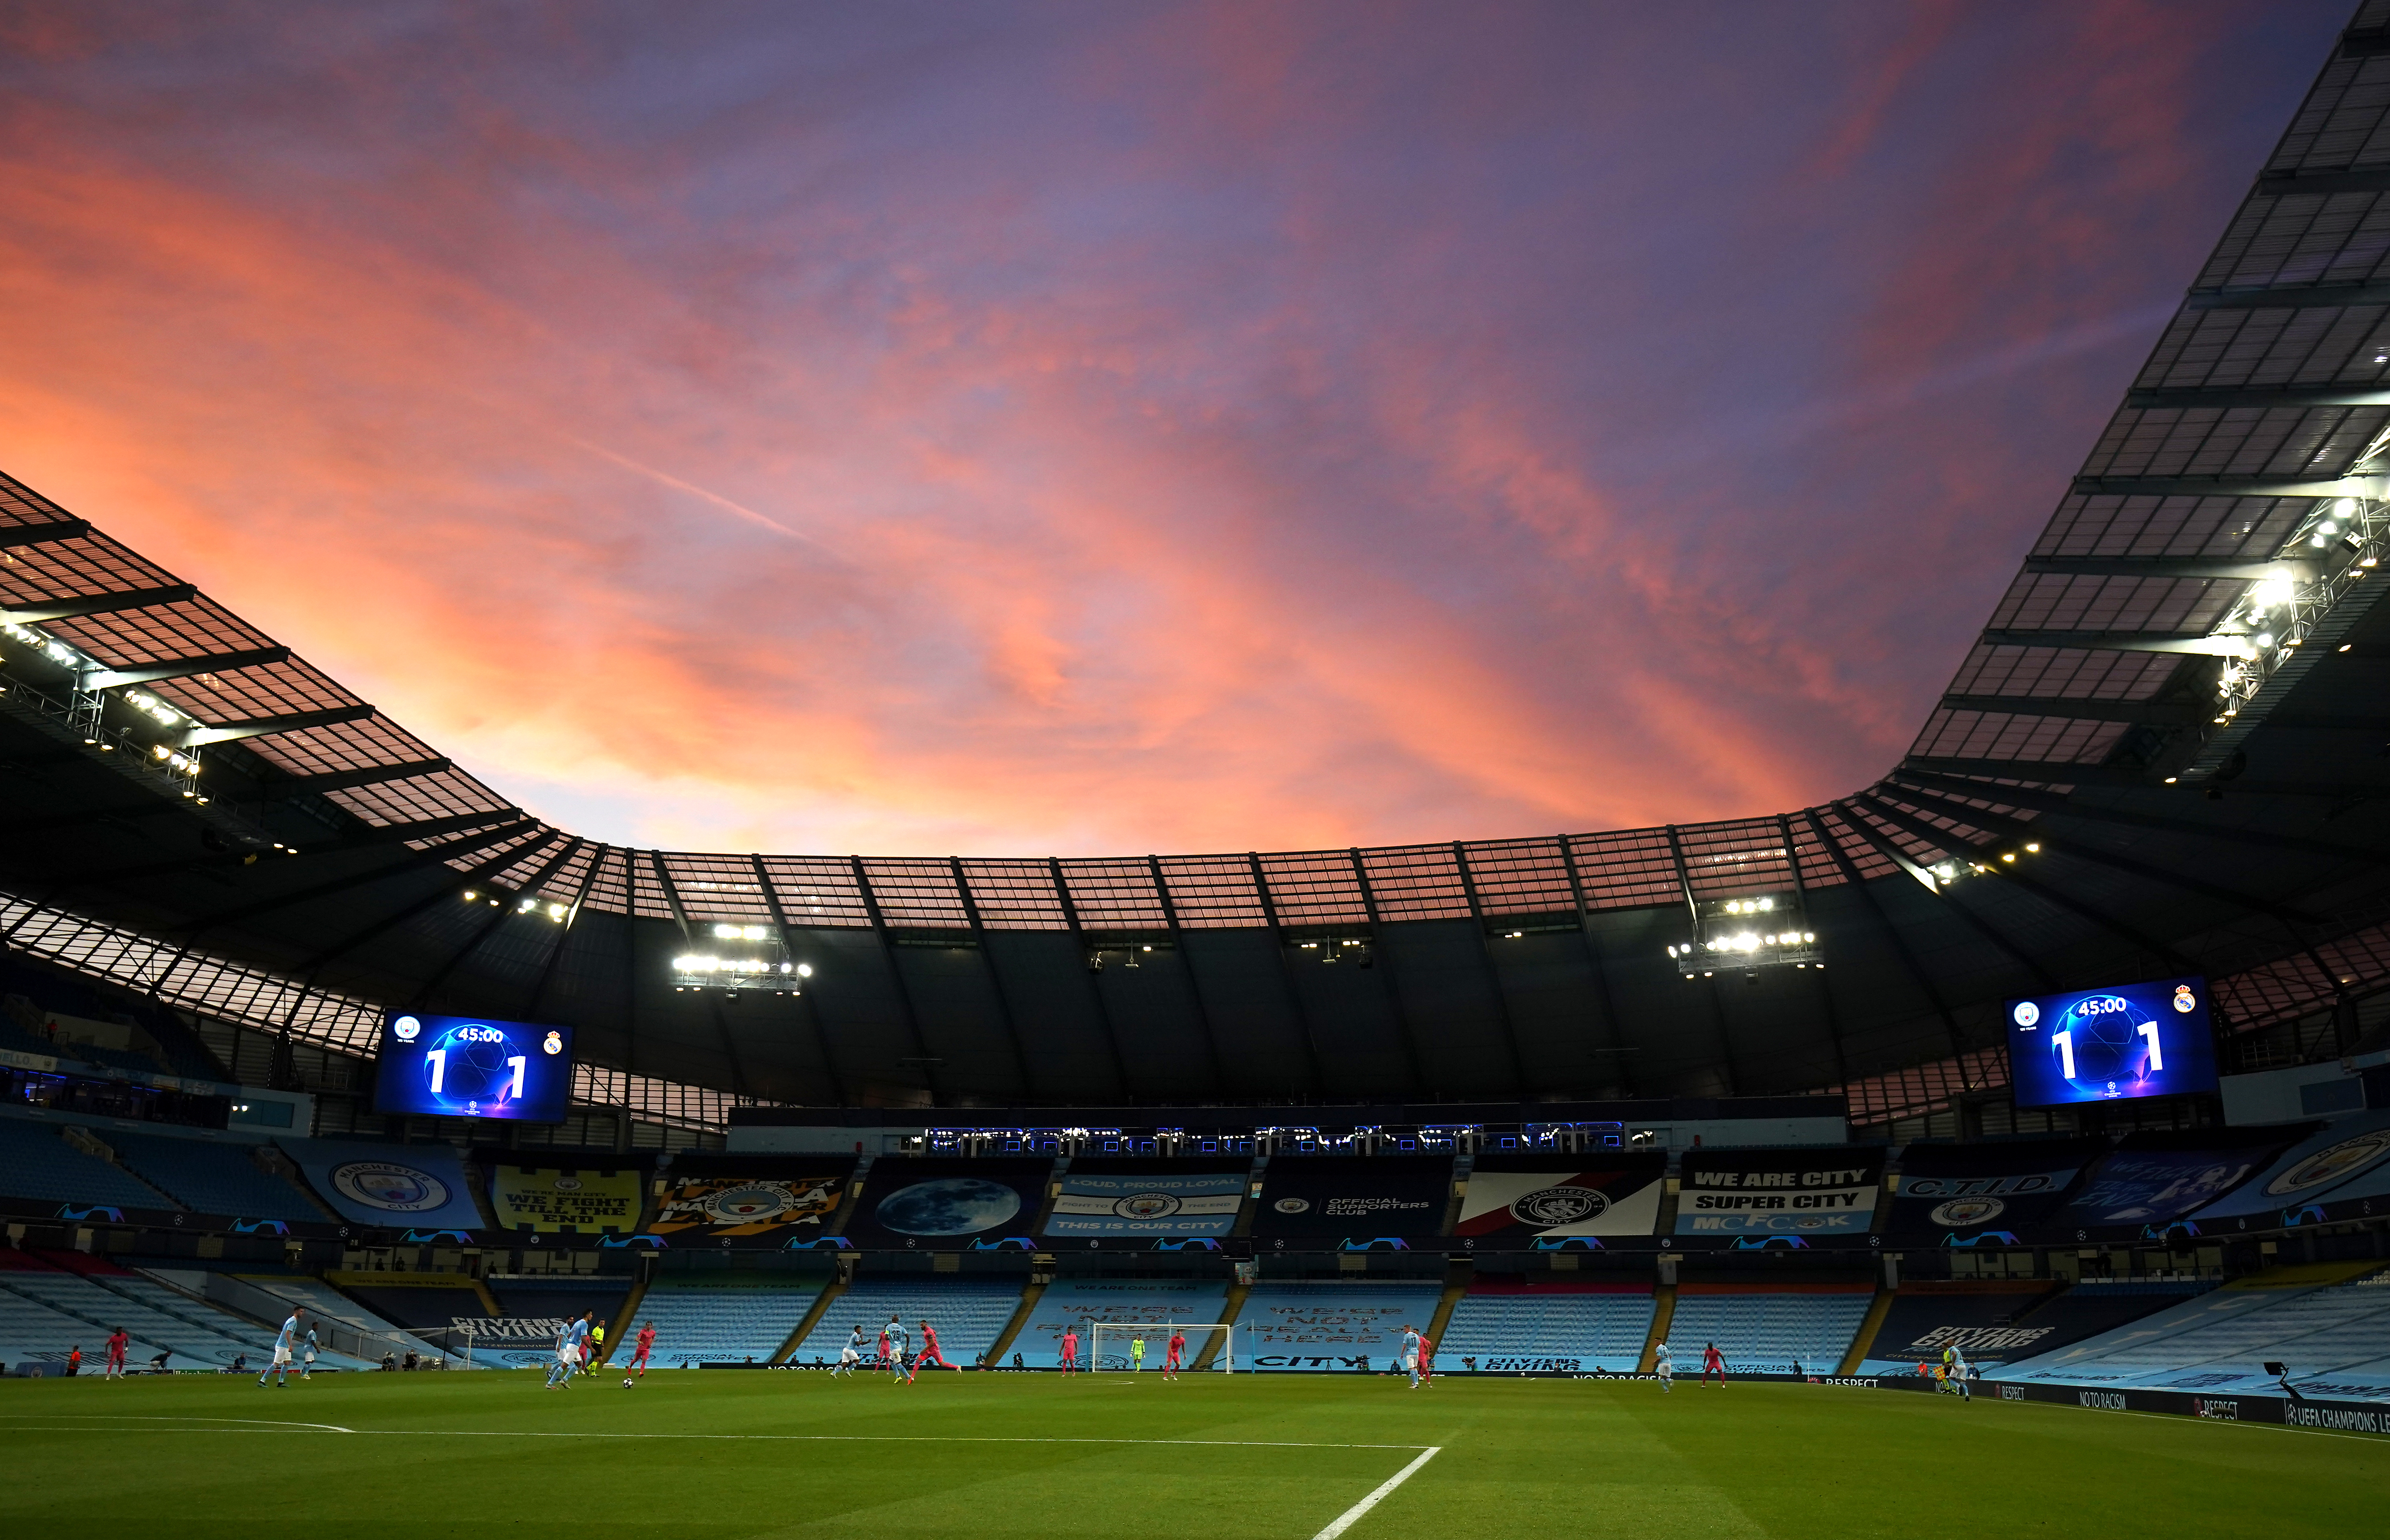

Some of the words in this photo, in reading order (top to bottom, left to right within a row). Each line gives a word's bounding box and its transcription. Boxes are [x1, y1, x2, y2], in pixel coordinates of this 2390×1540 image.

[2079, 997, 2126, 1015] 45:00
[458, 1027, 503, 1043] 45:00
[2052, 1031, 2075, 1079] 1
[2137, 1021, 2162, 1071] 1
[428, 1050, 446, 1093] 1
[508, 1056, 526, 1098] 1
[340, 1164, 430, 1181] MANCHESTER
[1695, 1171, 1739, 1187] WE
[1743, 1173, 1796, 1187] ARE
[1802, 1168, 1867, 1186] CITY
[1070, 1179, 1119, 1189] LOUD,
[1186, 1178, 1239, 1187] LOYAL
[1907, 1175, 2056, 1195] C.T.I.D.
[506, 1194, 546, 1204] WE
[556, 1197, 630, 1206] FIGHT
[708, 1185, 767, 1211] MANCHESTER
[772, 1188, 792, 1200] CITY
[1123, 1193, 1175, 1203] MANCHESTER
[1523, 1189, 1601, 1202] MANCHESTER
[1695, 1196, 1785, 1209] SUPER
[1793, 1192, 1859, 1208] CITY
[510, 1203, 568, 1214] TILL
[575, 1207, 626, 1215] THE
[542, 1215, 594, 1223] END
[452, 1317, 566, 1327] CITYZENS
[1263, 1335, 1382, 1343] HERE
[1930, 1326, 2056, 1337] CITYZENS
[1255, 1356, 1370, 1367] CITY
[2002, 1386, 2024, 1400] RESPECT
[2079, 1392, 2089, 1407] NO
[2090, 1392, 2100, 1408] TO
[2101, 1393, 2126, 1410] RACISM
[2298, 1408, 2321, 1427] UEFA
[2322, 1408, 2377, 1433] CHAMPIONS
